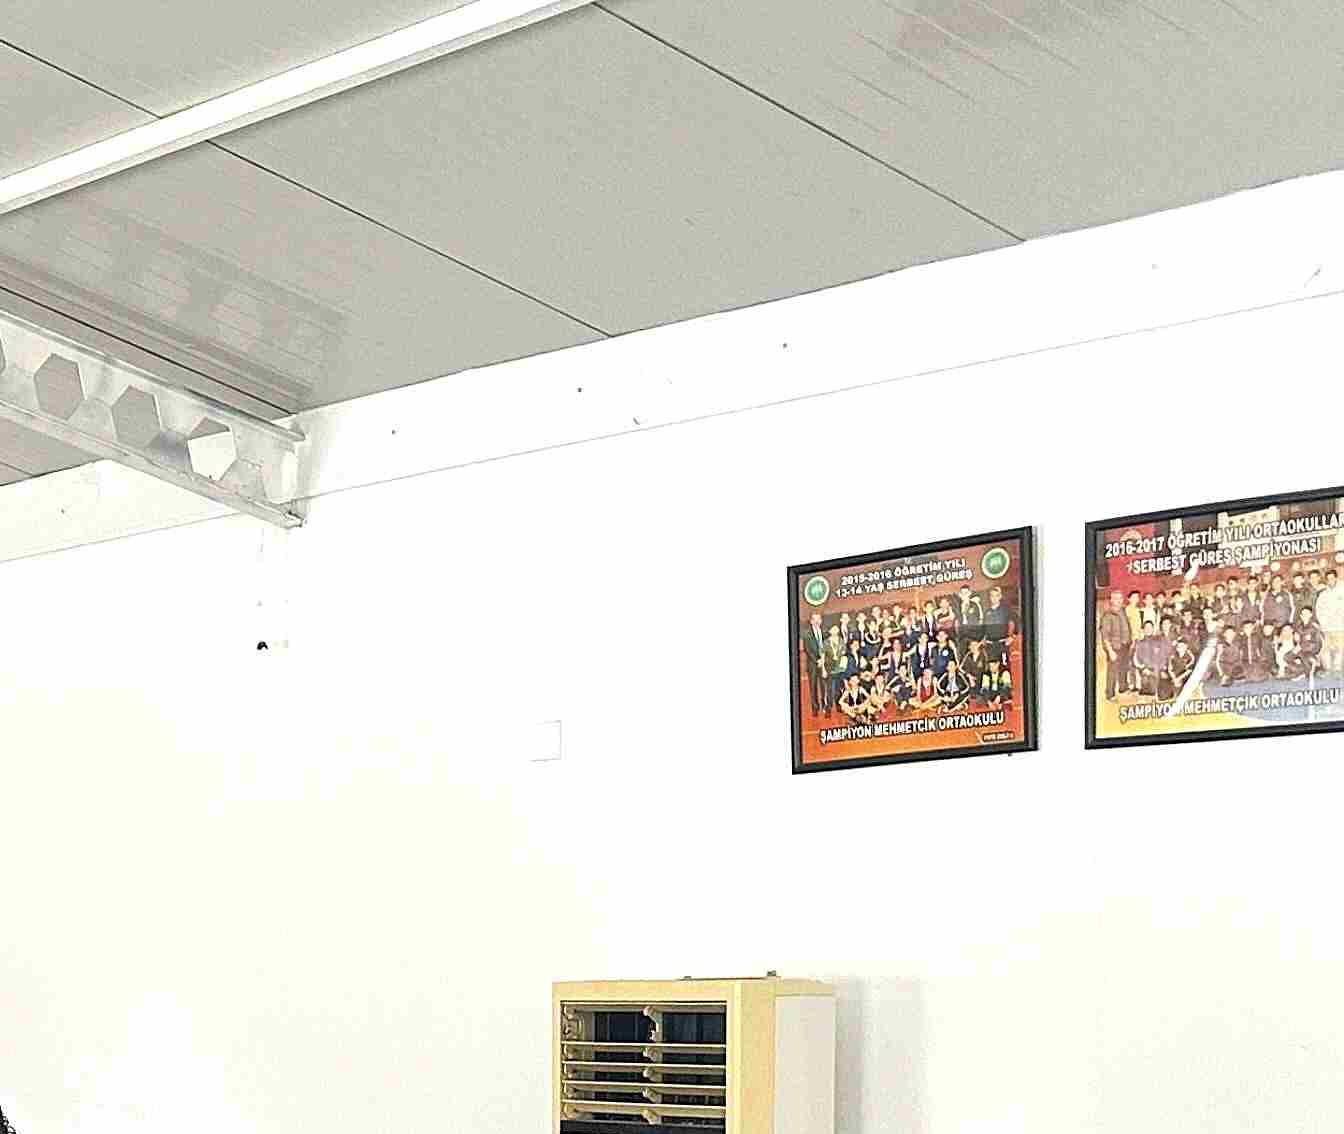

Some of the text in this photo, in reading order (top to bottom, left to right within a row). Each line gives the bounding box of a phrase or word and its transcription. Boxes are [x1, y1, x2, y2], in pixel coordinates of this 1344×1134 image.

[1105, 536, 1164, 559] 2016-2017
[1225, 526, 1251, 541] YILI
[1134, 553, 1187, 574] SERBEST
[1184, 694, 1259, 715] MEHMETÇİK
[1262, 687, 1340, 708] ORTAOKULU
[820, 724, 873, 744] ŞAMPİYON
[939, 711, 1005, 730] ORTAOKULU
